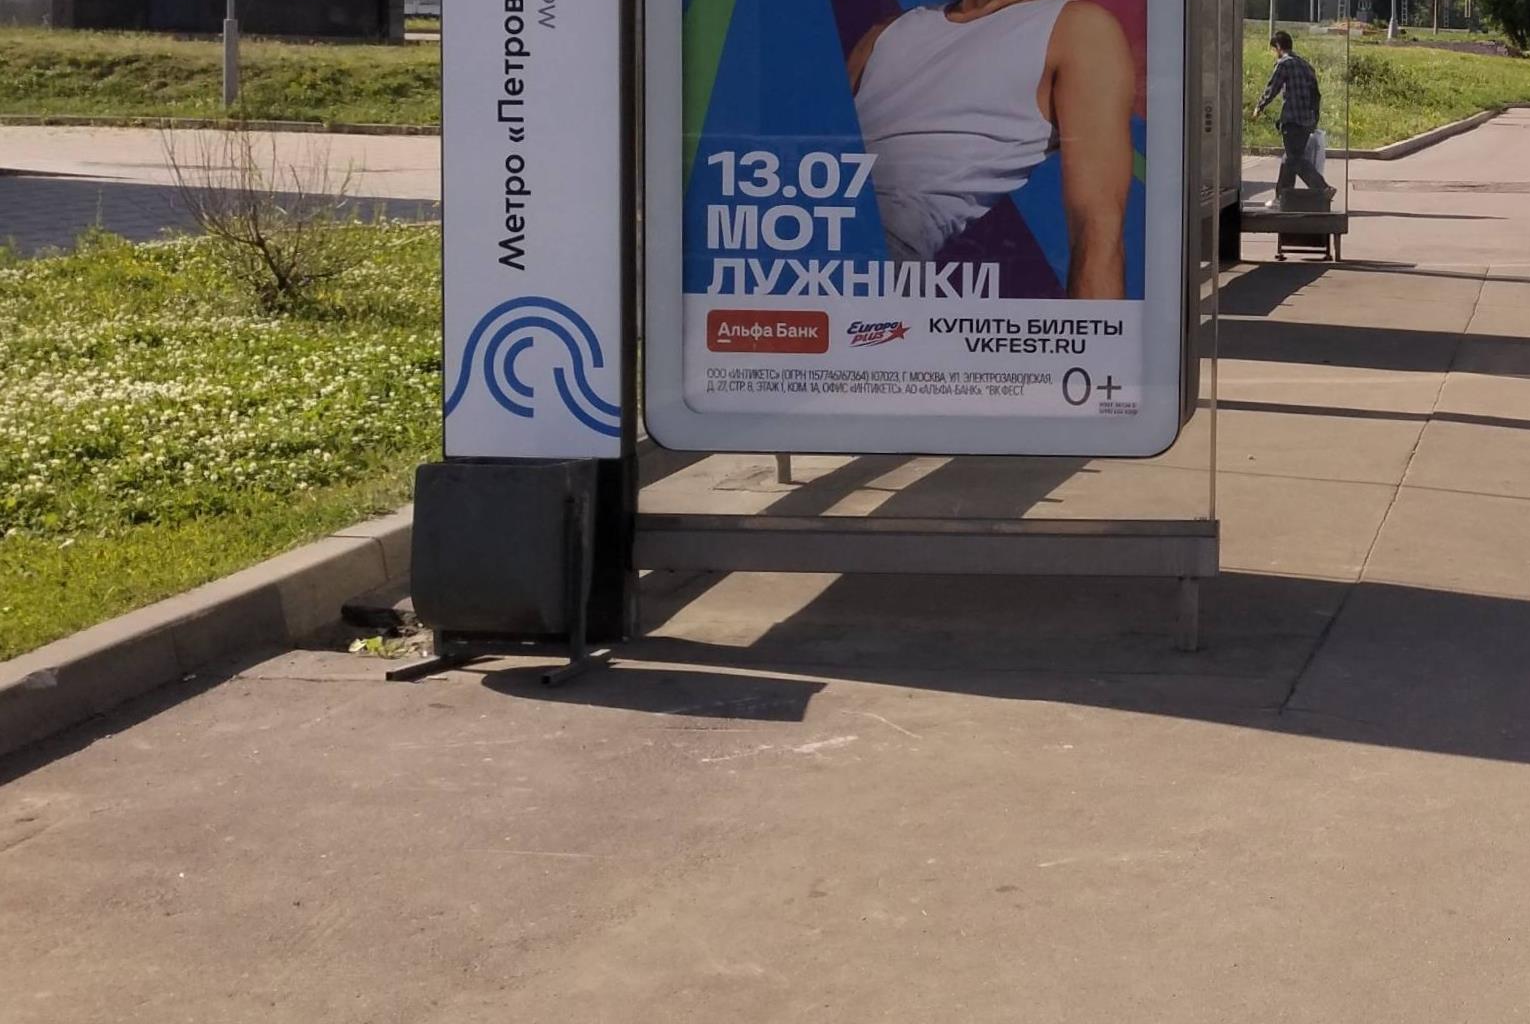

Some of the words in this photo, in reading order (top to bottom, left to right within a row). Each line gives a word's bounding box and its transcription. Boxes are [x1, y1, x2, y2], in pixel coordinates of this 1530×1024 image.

[707, 150, 879, 199] 13.07
[498, 154, 532, 271] Метро
[707, 204, 856, 252] МОТ
[706, 257, 1001, 299] ЛУЖНИКИ
[717, 322, 774, 343] Альфа
[776, 322, 819, 339] Банк
[929, 318, 1021, 335] КУПИТЬ
[1027, 319, 1123, 336] БИЛЕТЫ
[964, 337, 1086, 354] VKFEST.RU
[706, 368, 727, 379] ООО
[1062, 366, 1122, 406] 0+
